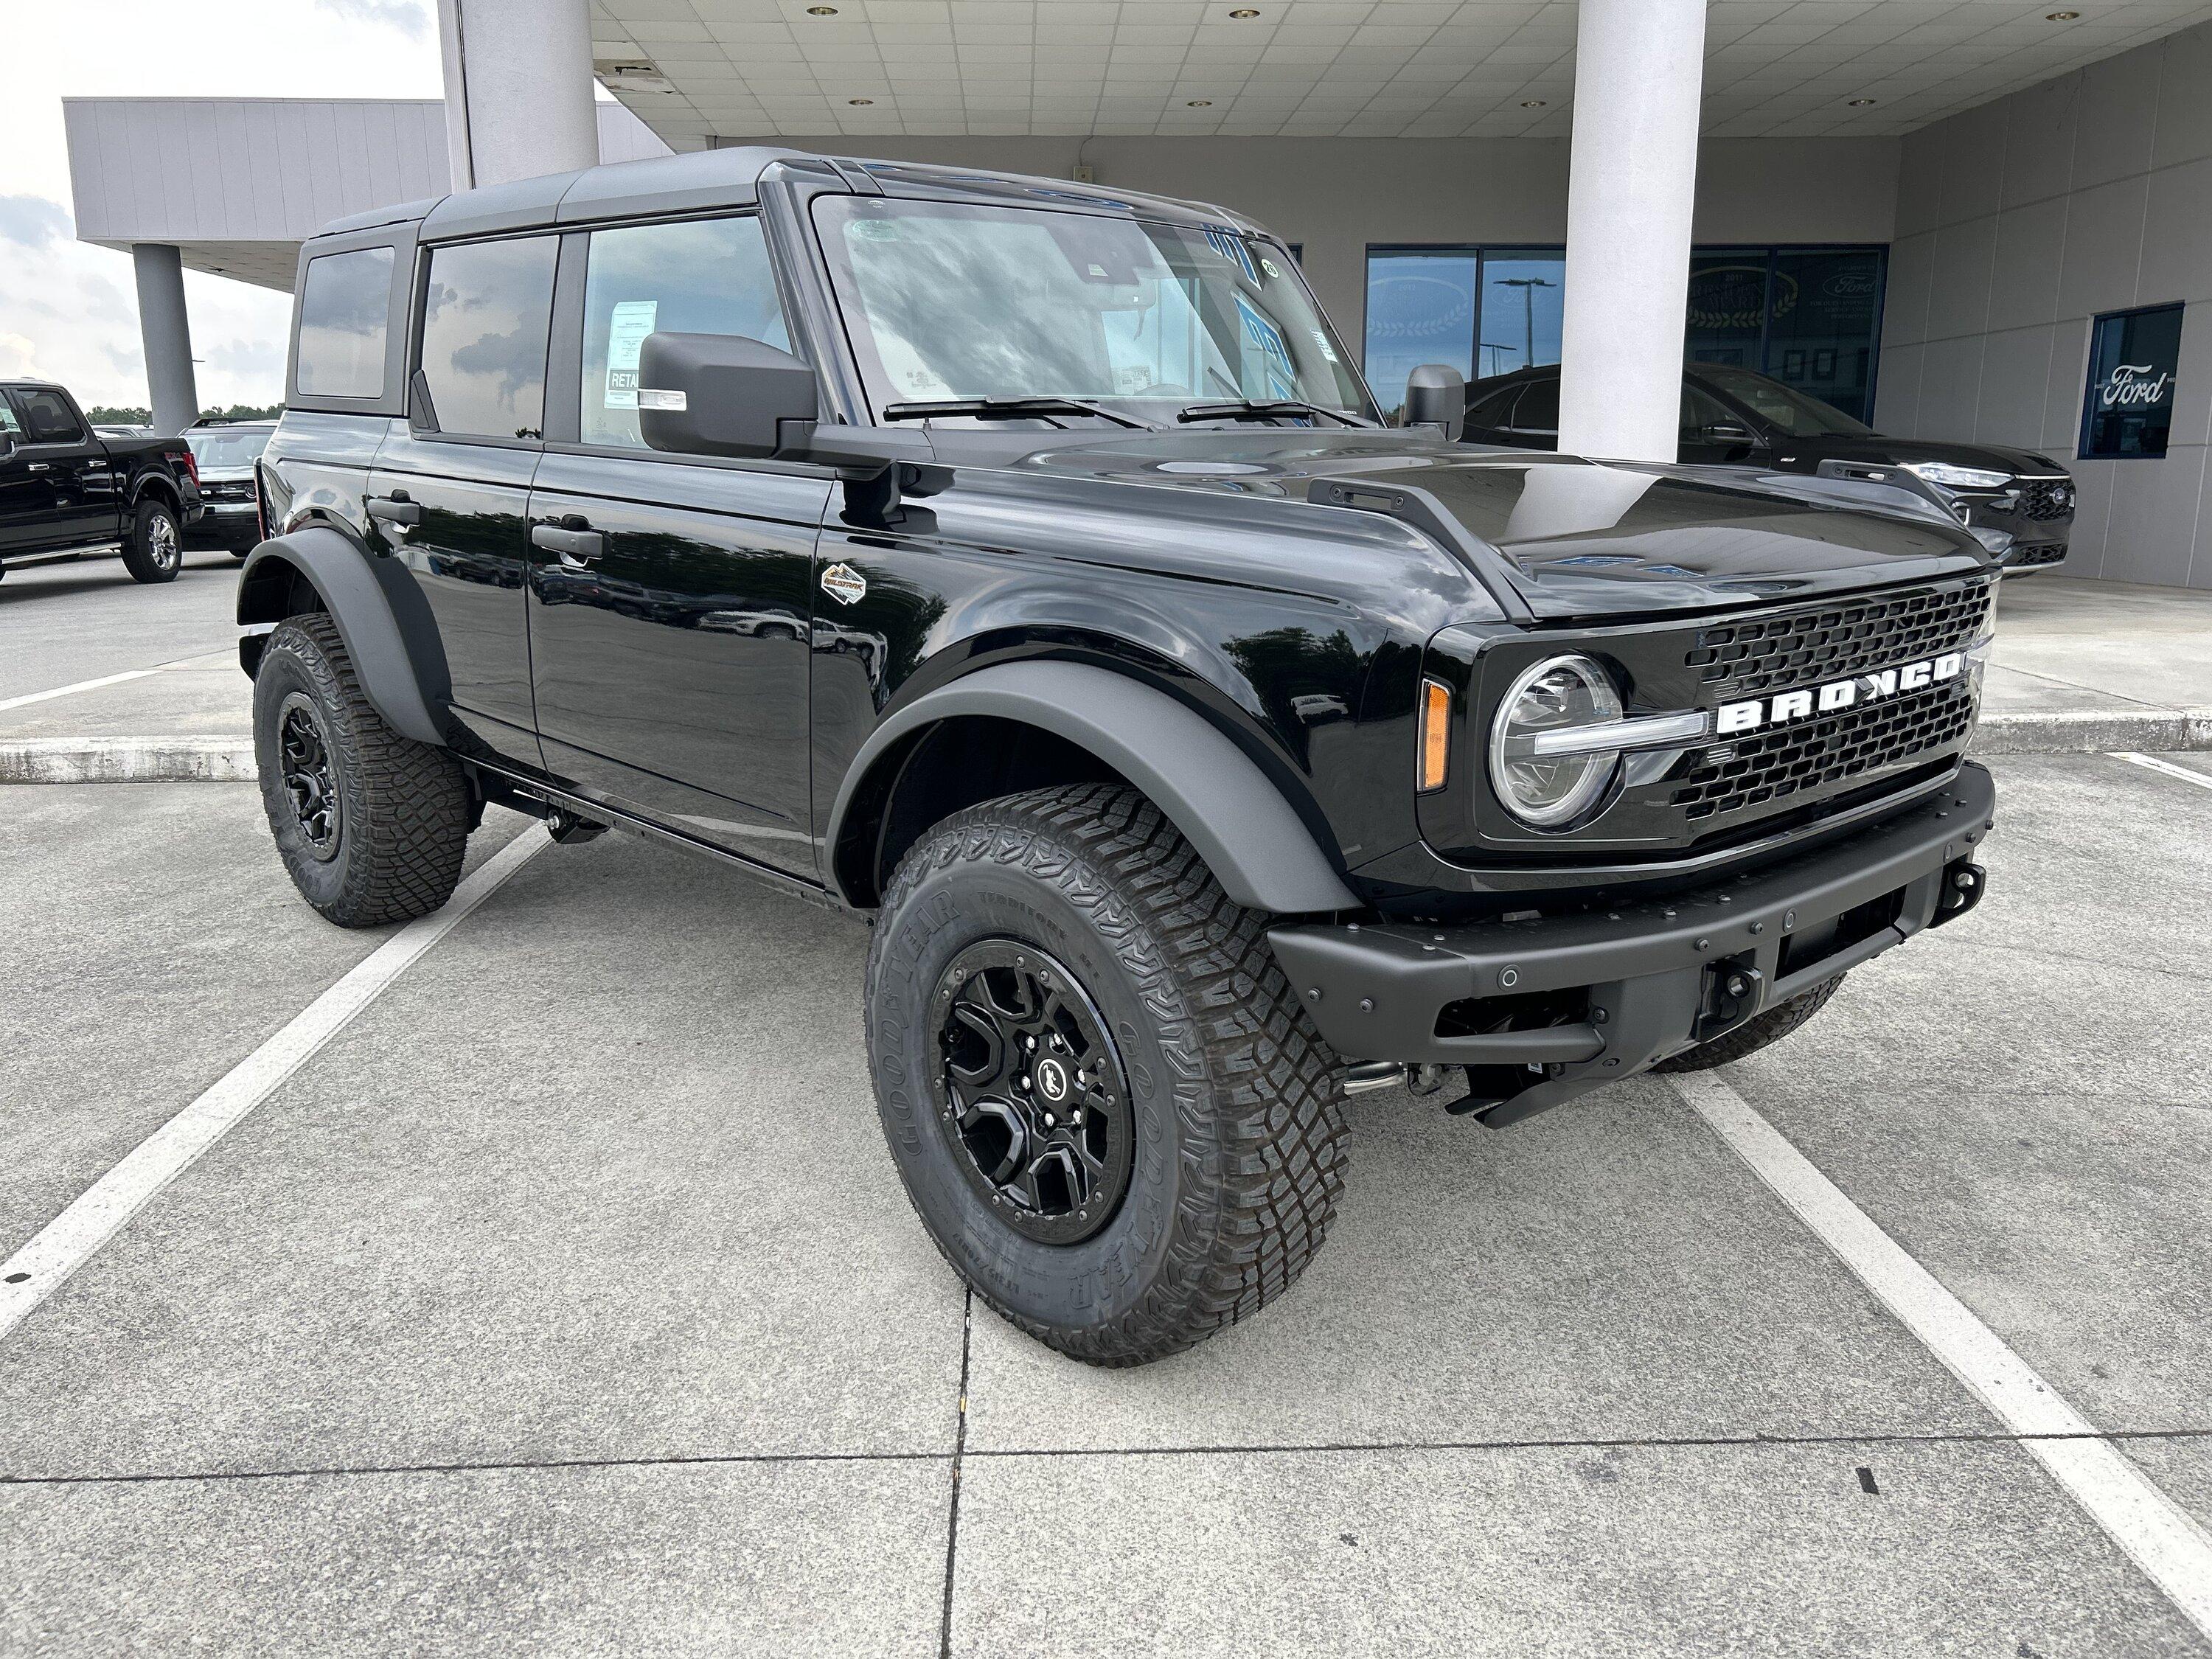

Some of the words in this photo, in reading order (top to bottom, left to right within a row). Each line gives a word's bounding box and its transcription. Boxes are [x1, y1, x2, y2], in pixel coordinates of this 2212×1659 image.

[1263, 262, 1277, 274] 26
[1725, 274, 1744, 282] 2011
[1834, 276, 1877, 293] Ford
[2103, 364, 2168, 405] Ford
[1716, 652, 1964, 735] BRONCO
[976, 890, 1069, 939] TERRITORY
[882, 888, 961, 1156] GOODYEAR
[1067, 1020, 1164, 1310] GOODYEAR
